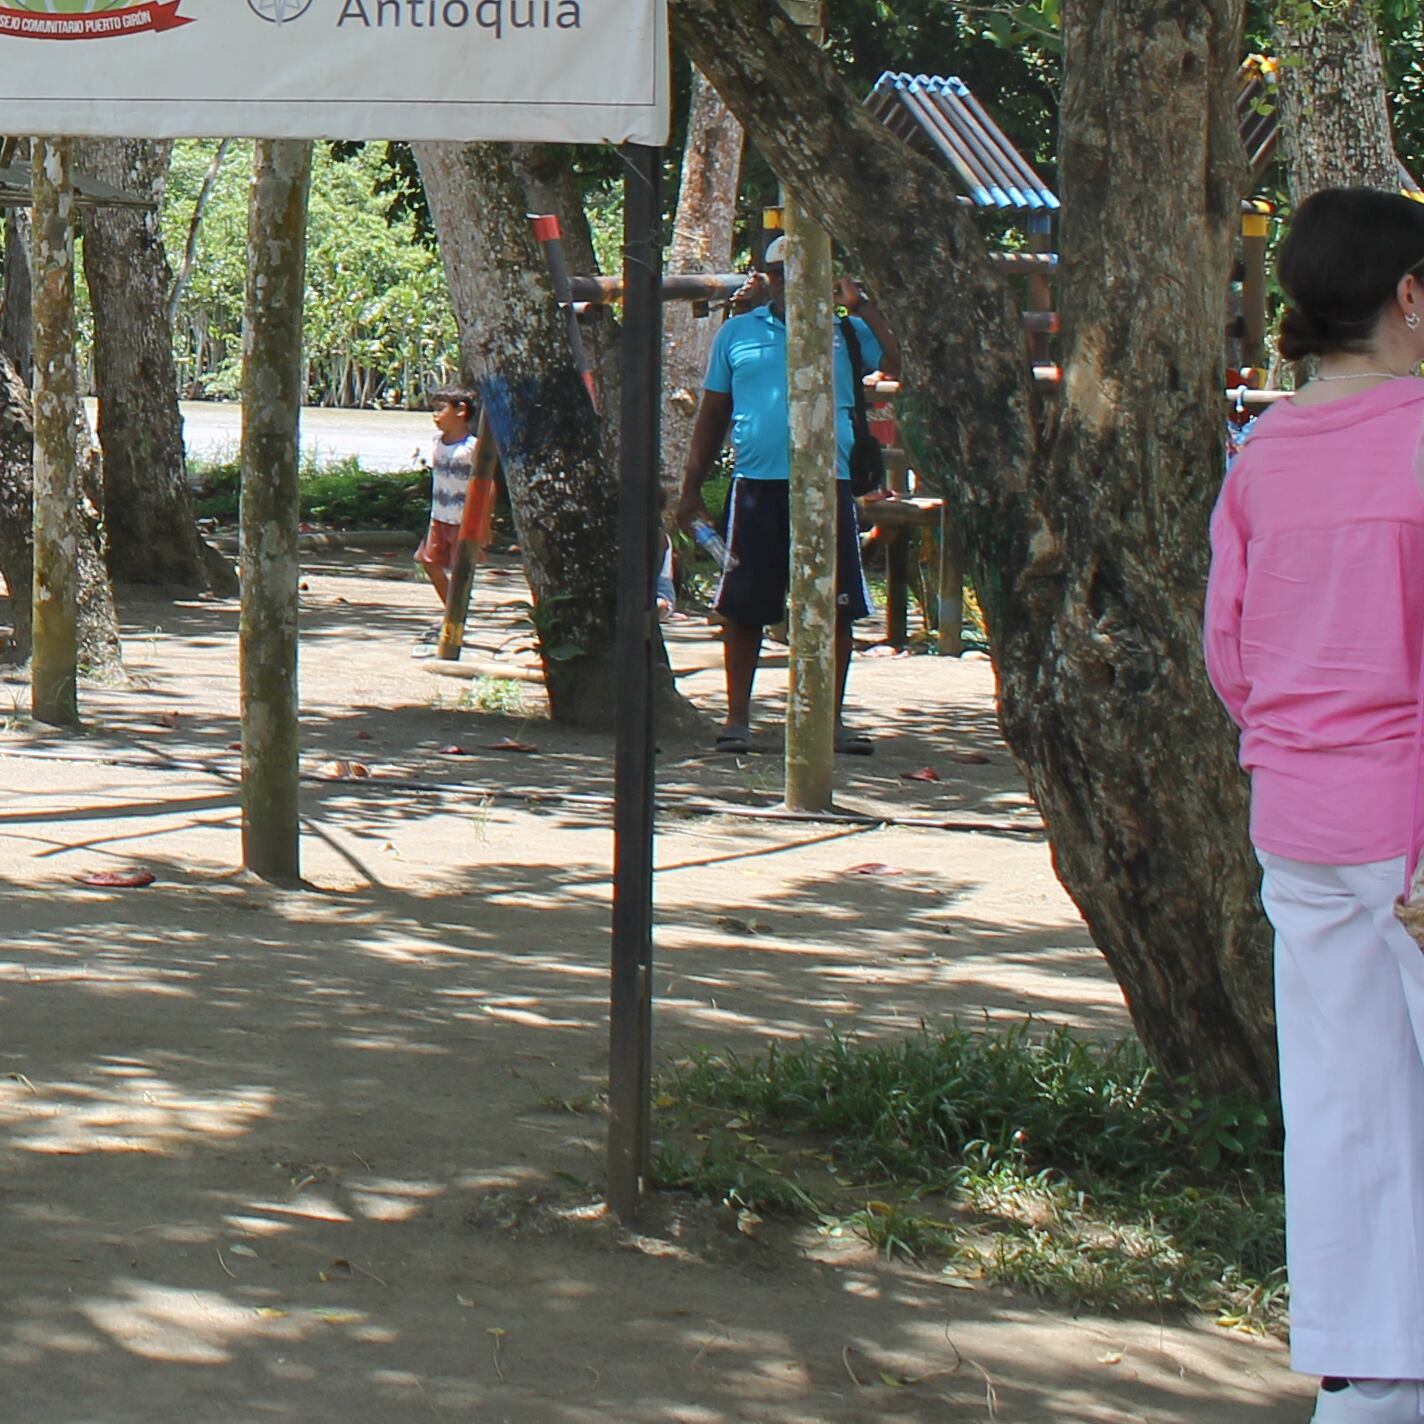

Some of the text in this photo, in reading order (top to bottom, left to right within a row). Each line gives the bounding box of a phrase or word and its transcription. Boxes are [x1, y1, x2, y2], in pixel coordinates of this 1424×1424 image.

[22, 18, 84, 34] COMUNITARIO
[85, 16, 121, 32] PUERTO
[122, 10, 152, 28] GIRÓN
